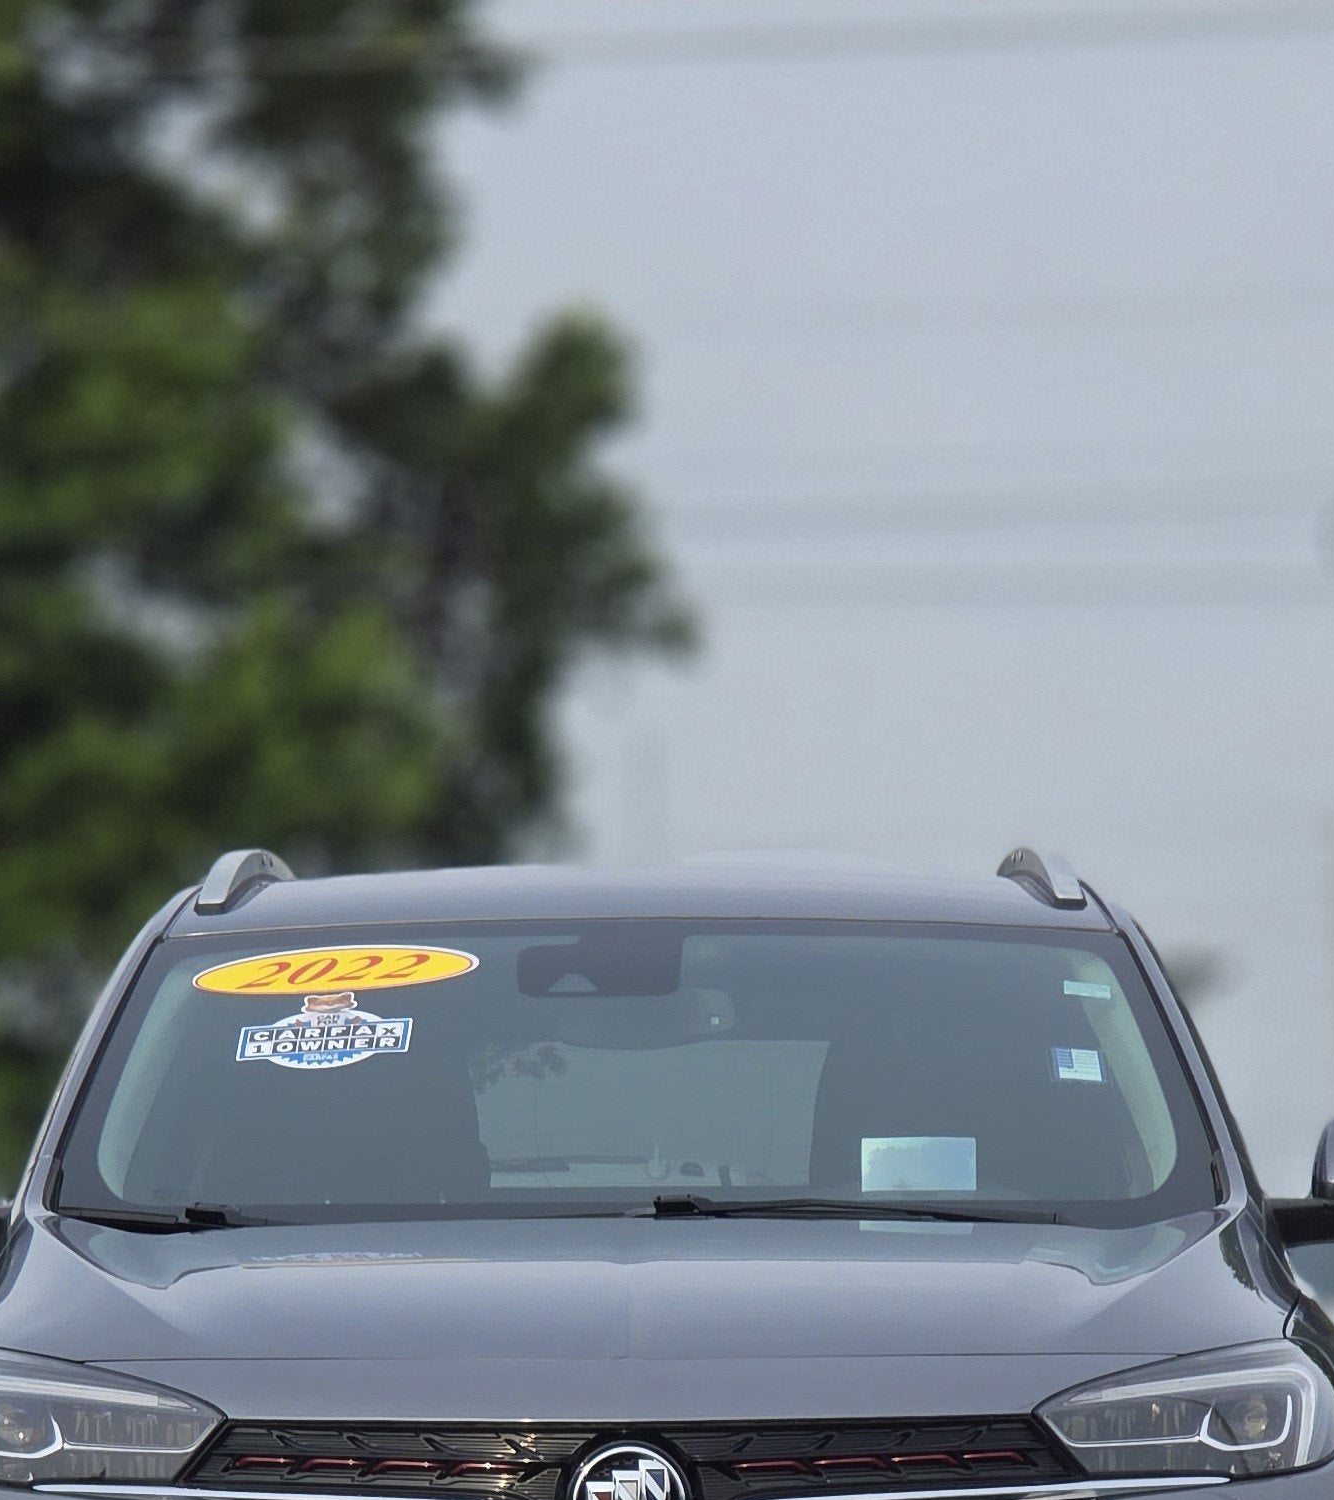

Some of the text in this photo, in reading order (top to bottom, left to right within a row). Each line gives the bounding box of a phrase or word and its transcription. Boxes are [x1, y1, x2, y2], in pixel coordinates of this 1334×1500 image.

[236, 954, 431, 989] 2022
[253, 1026, 397, 1041] CARFAX
[252, 1037, 396, 1054] 1 OWNER
